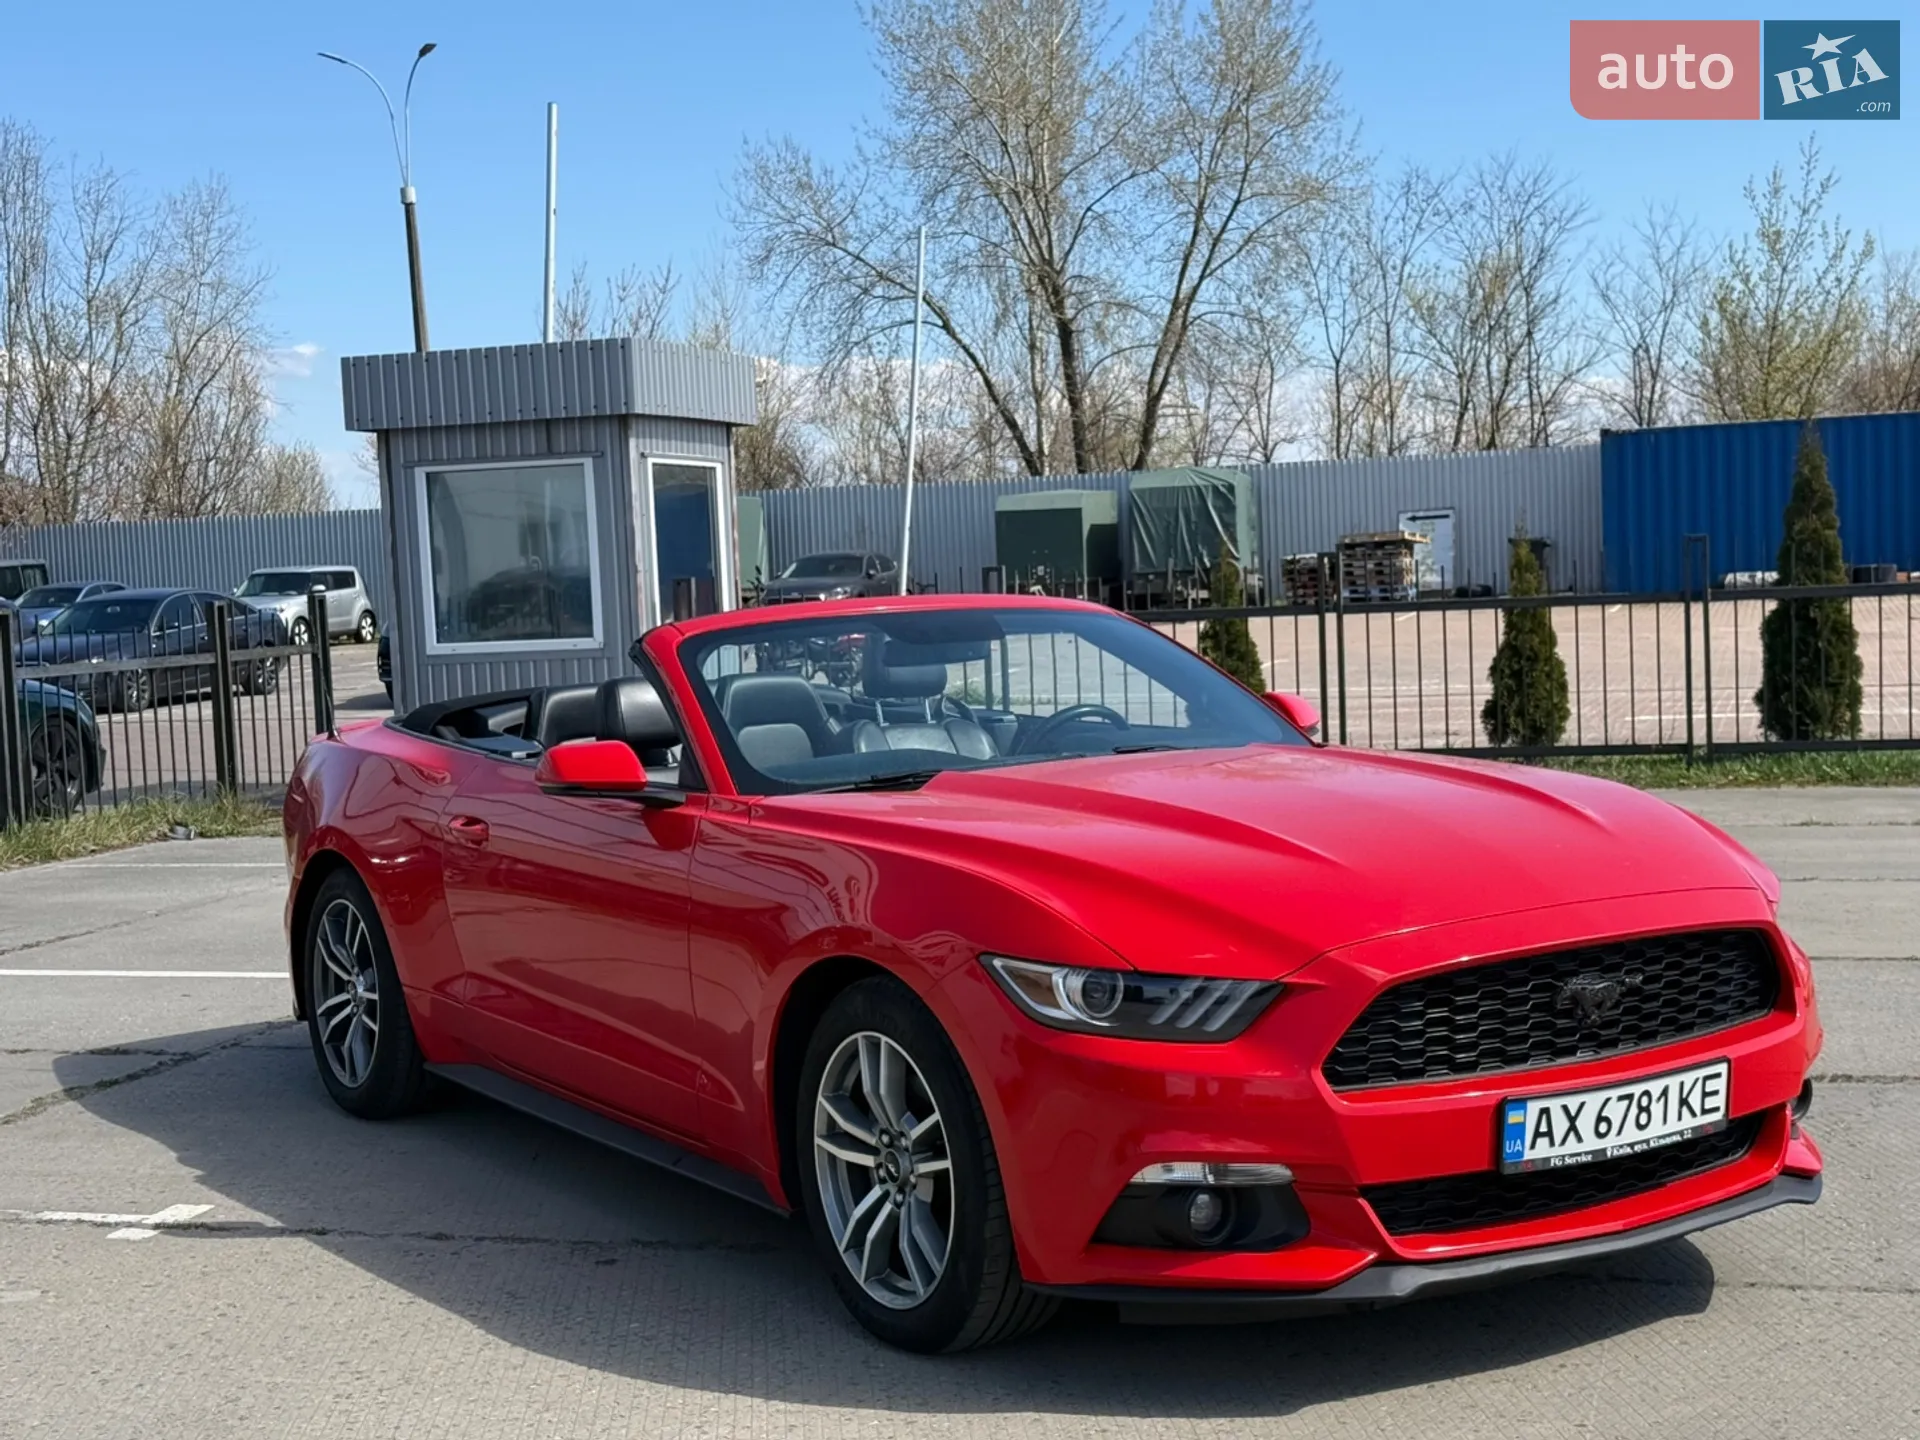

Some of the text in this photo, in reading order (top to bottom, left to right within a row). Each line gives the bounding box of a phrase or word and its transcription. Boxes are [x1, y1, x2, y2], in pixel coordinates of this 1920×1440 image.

[1529, 1071, 1722, 1151] AX 6781 KE
[1505, 1138, 1523, 1154] UA
[1550, 1153, 1593, 1167] FG Service
